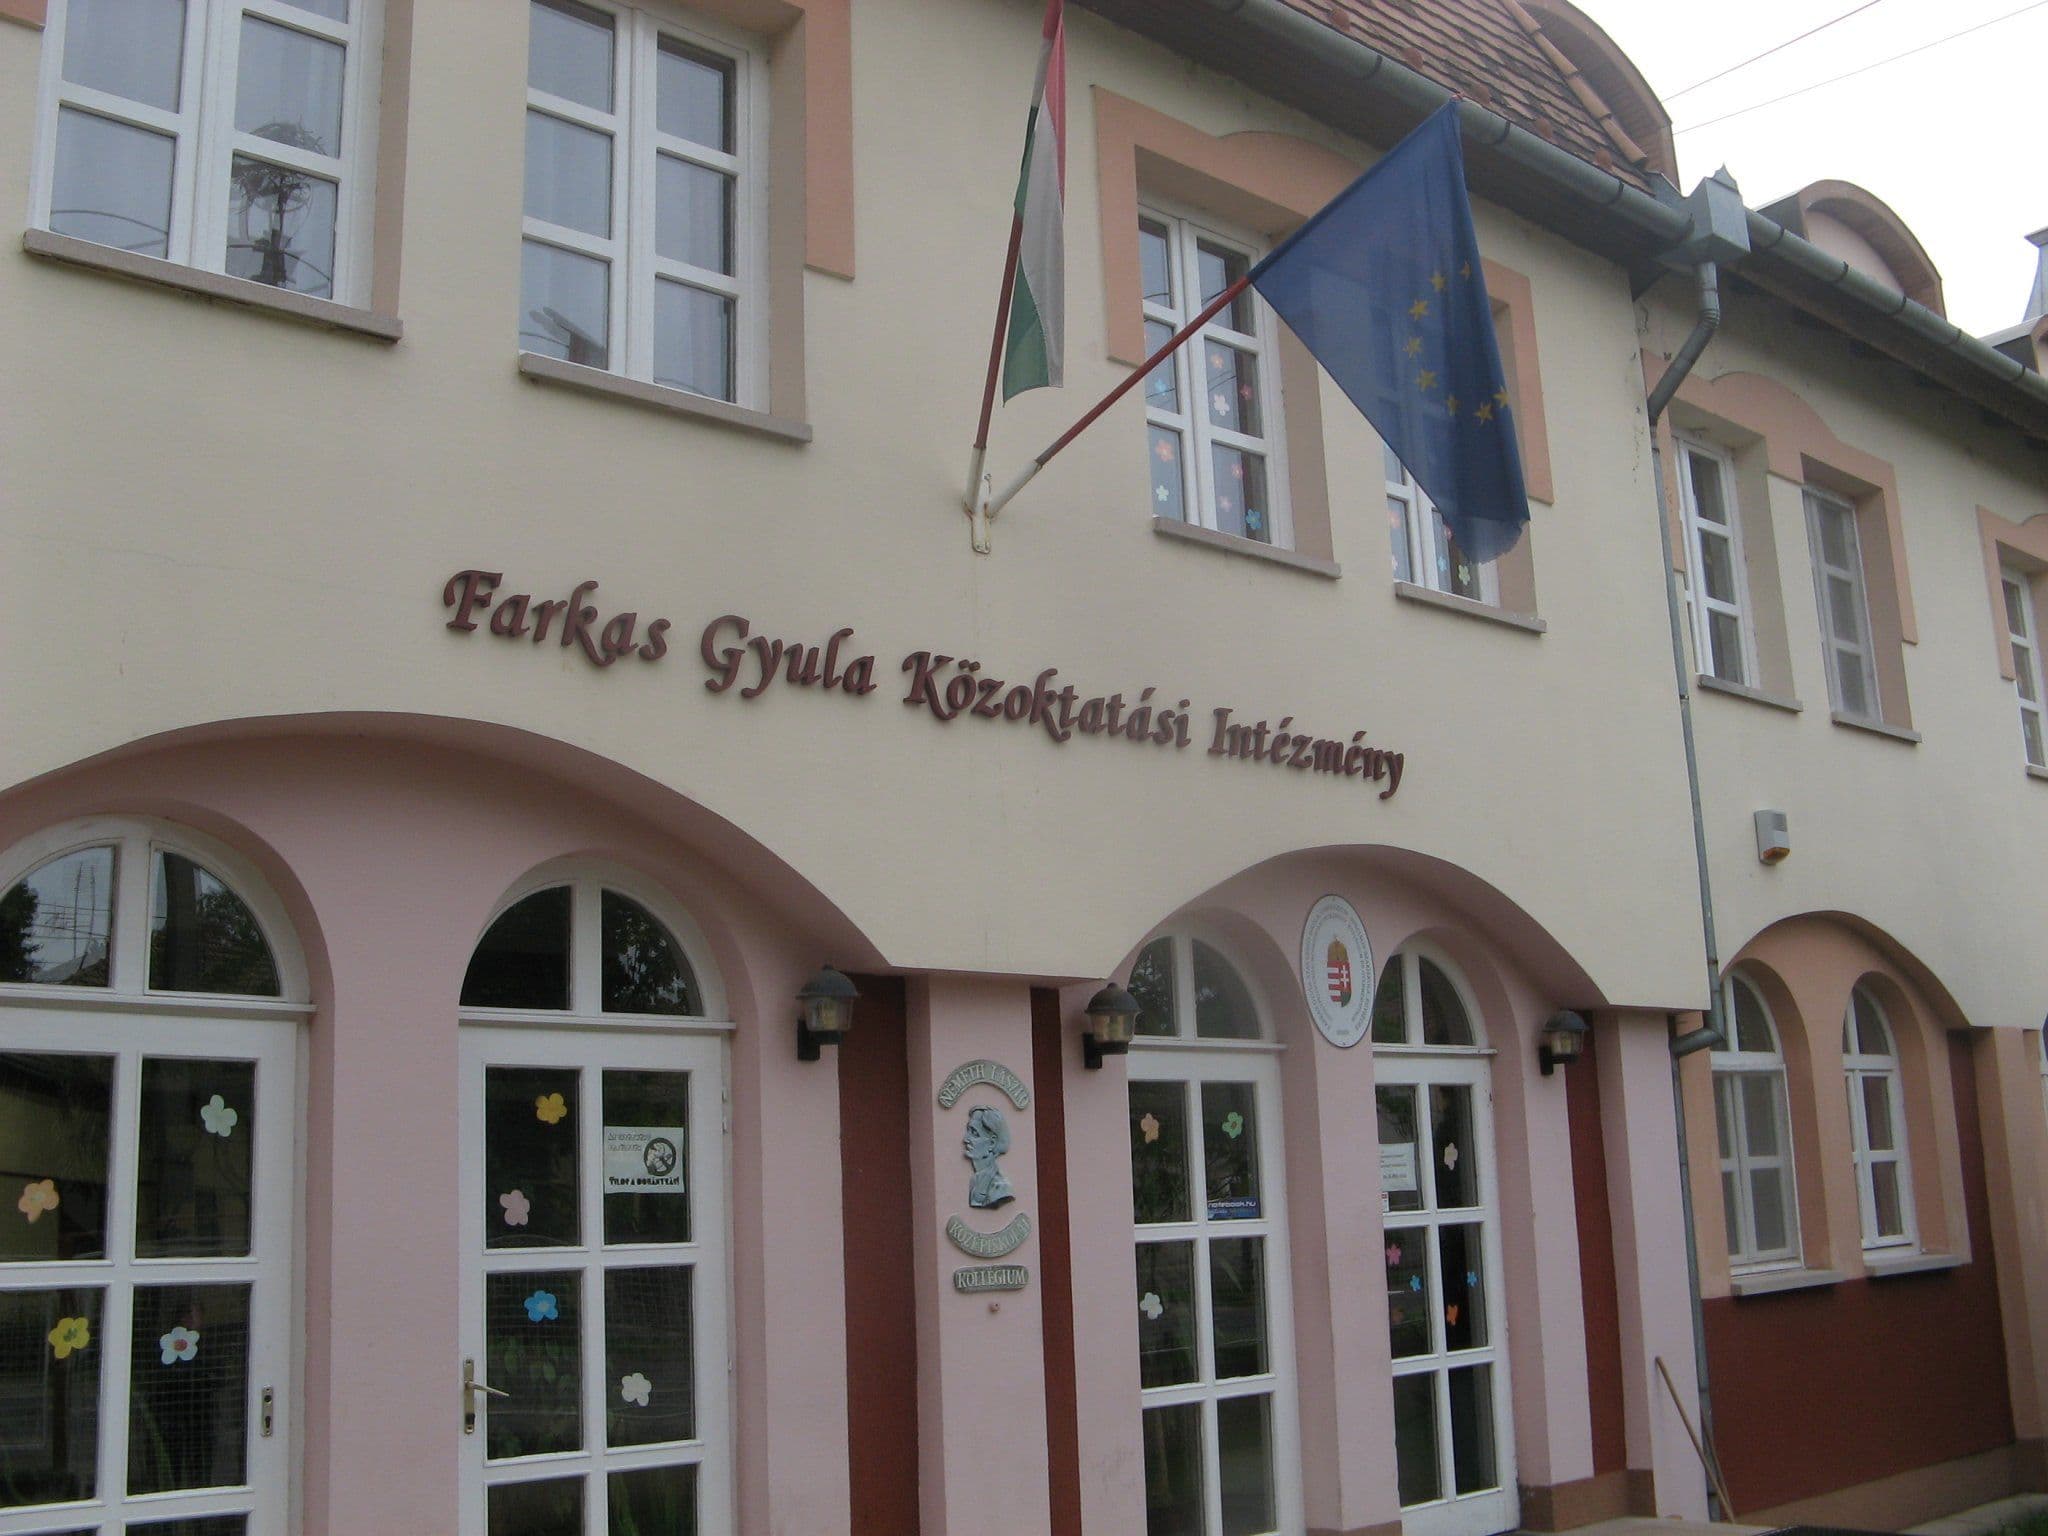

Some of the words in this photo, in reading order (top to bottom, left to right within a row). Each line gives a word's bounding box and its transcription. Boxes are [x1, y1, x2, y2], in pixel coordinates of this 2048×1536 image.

[443, 569, 671, 668] Farkas
[701, 614, 877, 699] Gyula
[902, 651, 1192, 743] Közoktatási
[1207, 707, 1404, 801] Intézmény
